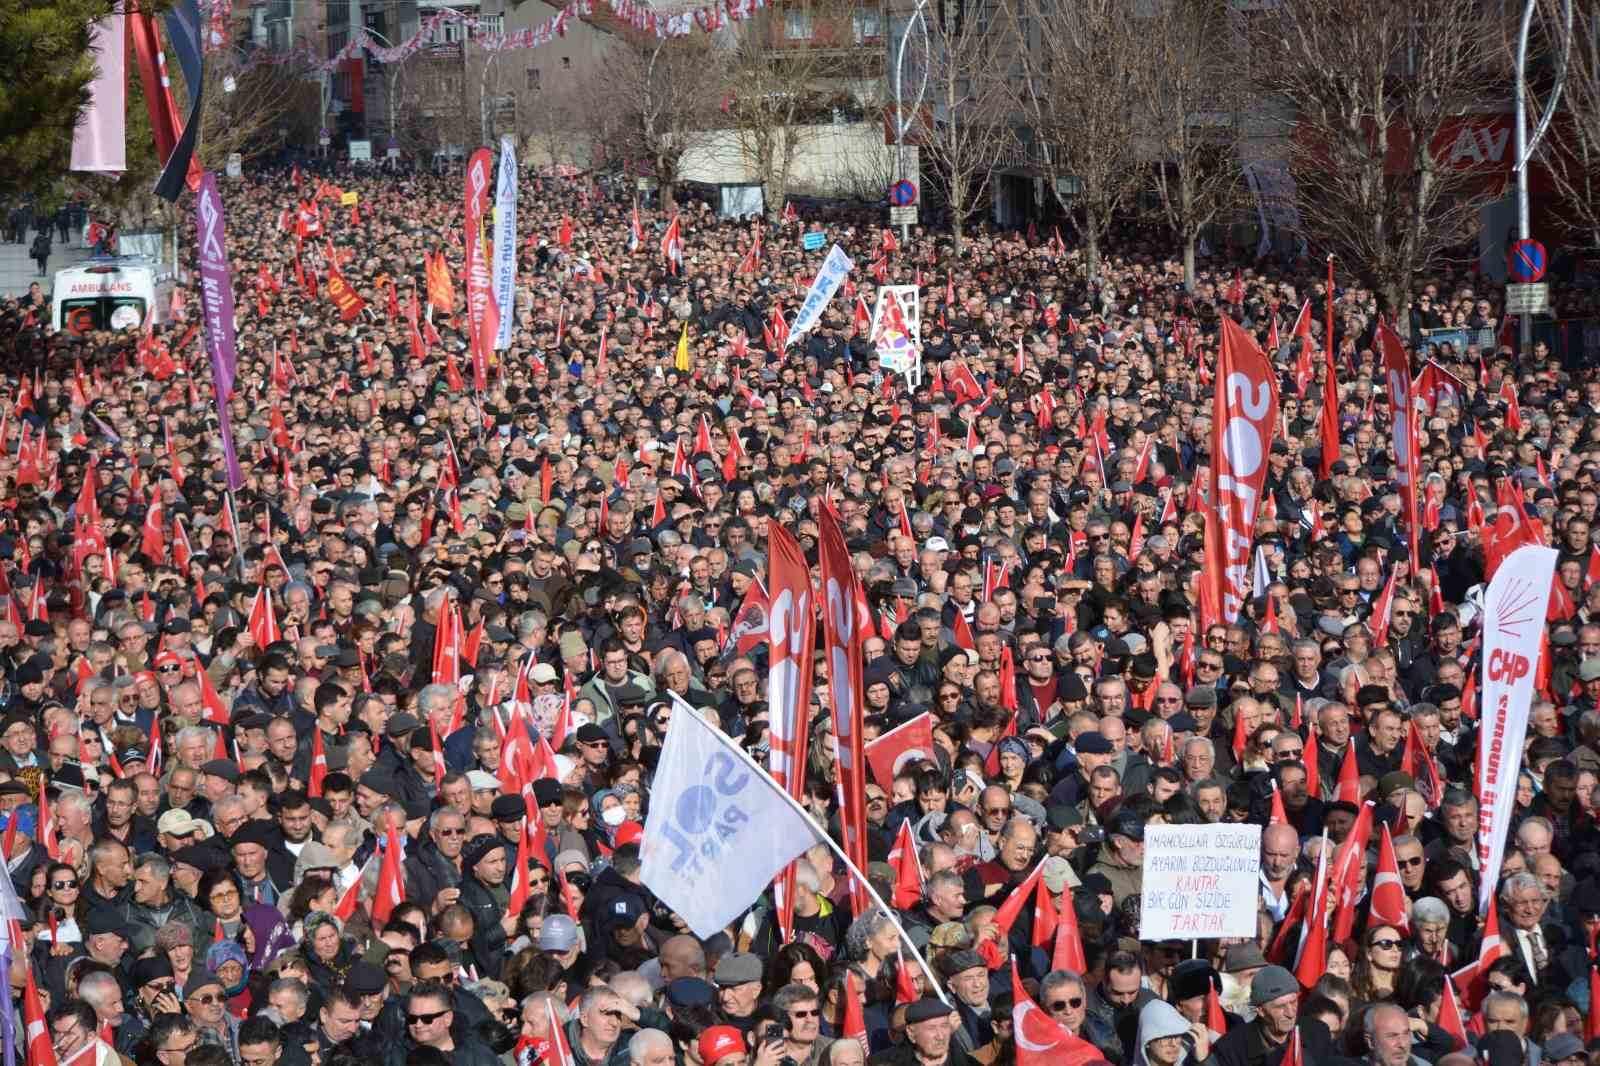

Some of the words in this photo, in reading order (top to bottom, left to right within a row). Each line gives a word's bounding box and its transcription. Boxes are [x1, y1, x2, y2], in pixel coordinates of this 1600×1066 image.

[71, 282, 132, 293] AMBULANS
[1488, 647, 1530, 686] CHP
[1176, 875, 1220, 892] KANTAR
[1171, 913, 1225, 932] TARTAR
